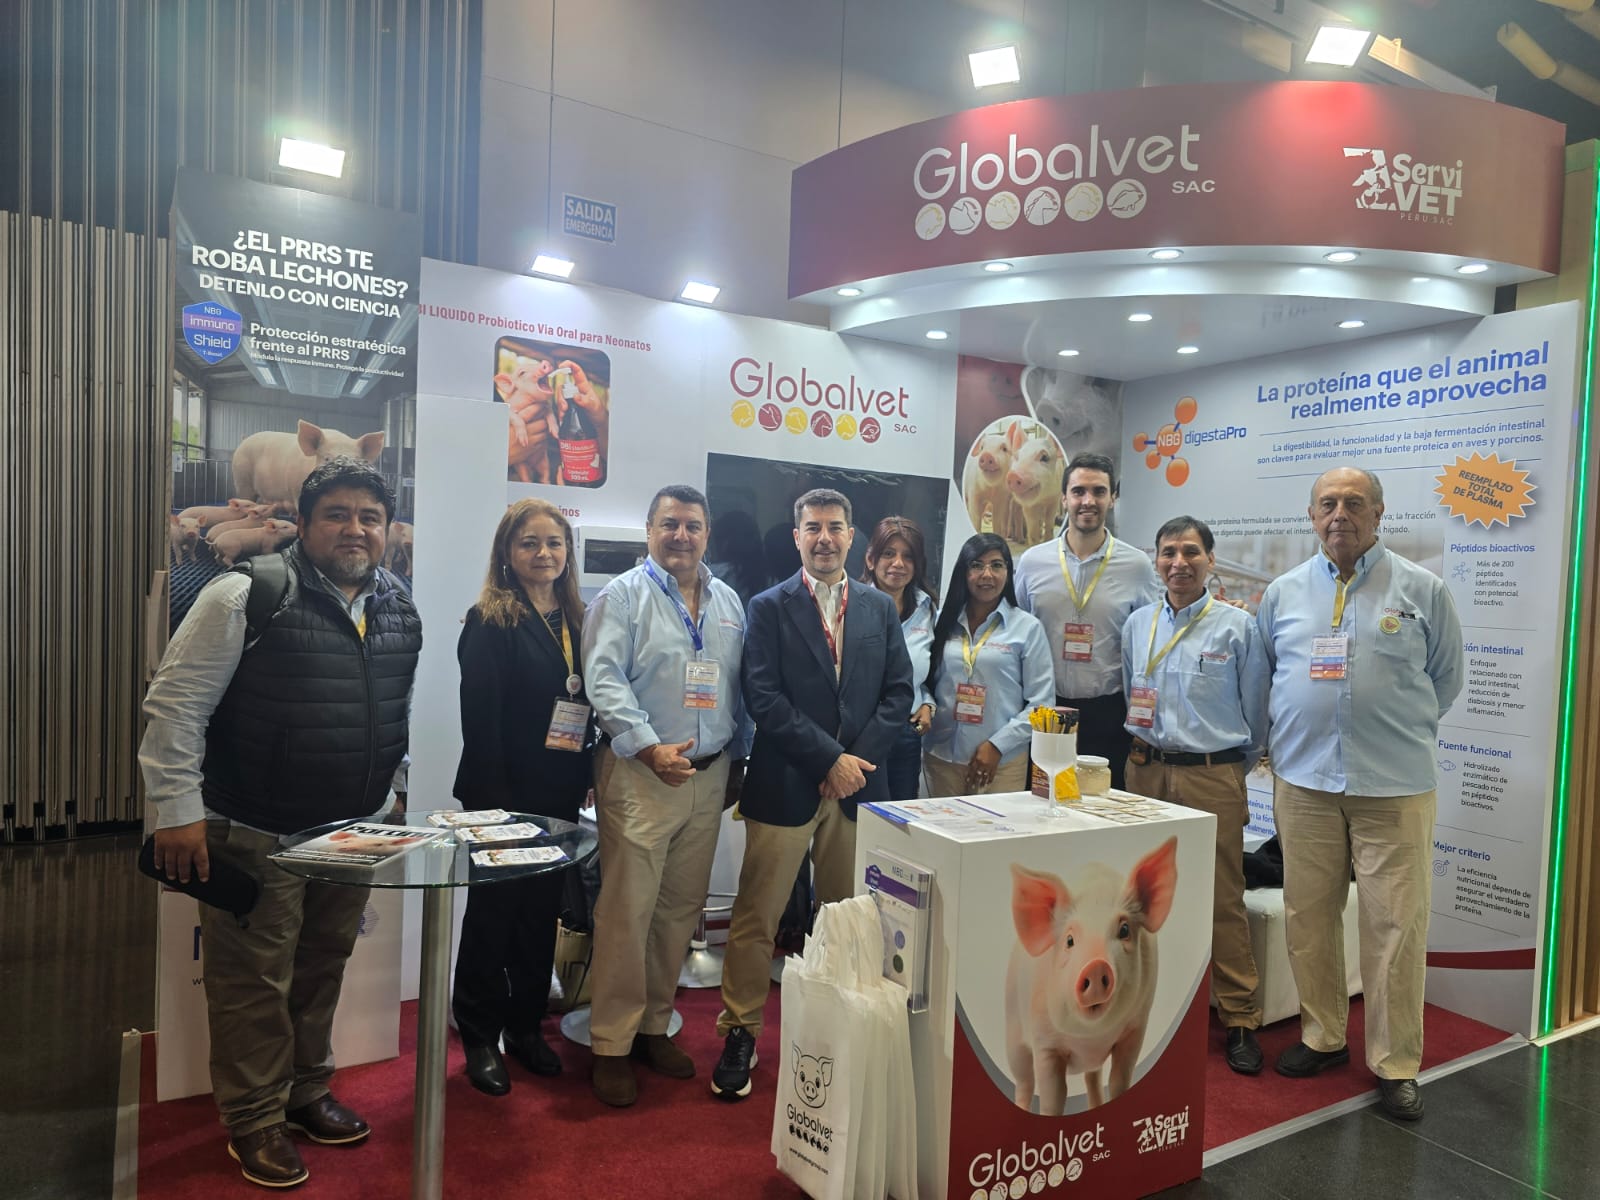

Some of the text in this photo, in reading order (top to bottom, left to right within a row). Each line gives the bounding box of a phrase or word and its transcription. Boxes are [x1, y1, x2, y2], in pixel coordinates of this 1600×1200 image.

[913, 124, 1216, 200] Globalvet SAC
[1391, 153, 1463, 189] Servi
[1393, 182, 1462, 217] VET
[566, 199, 613, 225] SALIDA
[1400, 213, 1453, 226] PERU SAC
[566, 218, 613, 240] EMERGENCIA
[233, 229, 374, 271] ¿EL PRRS TE
[192, 245, 409, 299] ROBA LECHONES?
[199, 273, 401, 319] DETENLO CON CIENCIA
[429, 305, 475, 323] LIQUIDO
[478, 313, 535, 333] Probiotico
[537, 323, 554, 336] Via
[557, 326, 577, 340] Oral
[580, 332, 603, 344] para
[605, 334, 652, 352] Neonatos
[193, 333, 231, 350] Shield
[250, 323, 406, 356] Protección estratégica
[250, 337, 350, 361] frente al PRRS
[1257, 340, 1549, 403] La proteína que el animal
[730, 357, 917, 434] Globalvet SAC
[1290, 370, 1547, 419] realmente aprovecha
[1157, 426, 1247, 447] NBG digestaPro
[1333, 438, 1340, 446] la
[1342, 433, 1395, 446] funcionalidad
[1397, 434, 1402, 442] y
[1404, 432, 1412, 440] la
[1414, 430, 1432, 440] baja
[1434, 423, 1496, 438] fermentación
[1498, 418, 1545, 431] intestinal
[1257, 456, 1270, 464] son
[1272, 454, 1294, 463] claves
[1295, 453, 1312, 462] para
[1313, 450, 1340, 460] evaluar
[1342, 448, 1365, 458] mejor
[1384, 444, 1411, 454] fuente
[1466, 439, 1488, 448] aves
[1490, 438, 1496, 448] y
[1498, 434, 1544, 447] porcinos.
[1458, 470, 1513, 494] REEMPLAZO
[1468, 482, 1495, 498] TOTAL
[1453, 486, 1504, 510] DE PLASMA
[1396, 512, 1404, 520] la
[1404, 510, 1436, 520] fracción
[1264, 528, 1285, 536] afectar
[1450, 544, 1536, 555] Péptidos bioactivos
[1476, 560, 1490, 568] Más
[1492, 560, 1500, 568] de
[1475, 580, 1517, 588] identificados
[1488, 590, 1518, 598] potencial
[1474, 598, 1504, 606] bioactivo.
[1481, 644, 1524, 656] intestinal
[1470, 659, 1496, 668] Enfoque
[1470, 669, 1508, 679] relacionado
[1468, 688, 1500, 698] reducción
[1488, 680, 1520, 690] intestinal,
[1468, 698, 1496, 706] disbiosis
[1502, 702, 1526, 710] menor
[1438, 740, 1512, 759] Fuente funcional
[1464, 761, 1500, 773] Hidrolizado
[1462, 772, 1498, 783] enzimático
[1462, 781, 1490, 790] pescado
[1460, 799, 1495, 811] bioactivos.
[1471, 790, 1499, 802] péptidos
[1458, 848, 1491, 861] criterio
[1457, 864, 1497, 880] La eficiencia
[1456, 876, 1490, 888] nutricional
[1492, 884, 1520, 896] depende
[1456, 885, 1486, 897] asegurar
[1494, 894, 1530, 908] verdadero
[1456, 894, 1512, 914] aprovechamiento
[786, 1103, 833, 1142] Globalvet
[1154, 1105, 1189, 1132] Servi
[1155, 1122, 1189, 1147] VET
[968, 1122, 1111, 1188] Globalvet SAC
